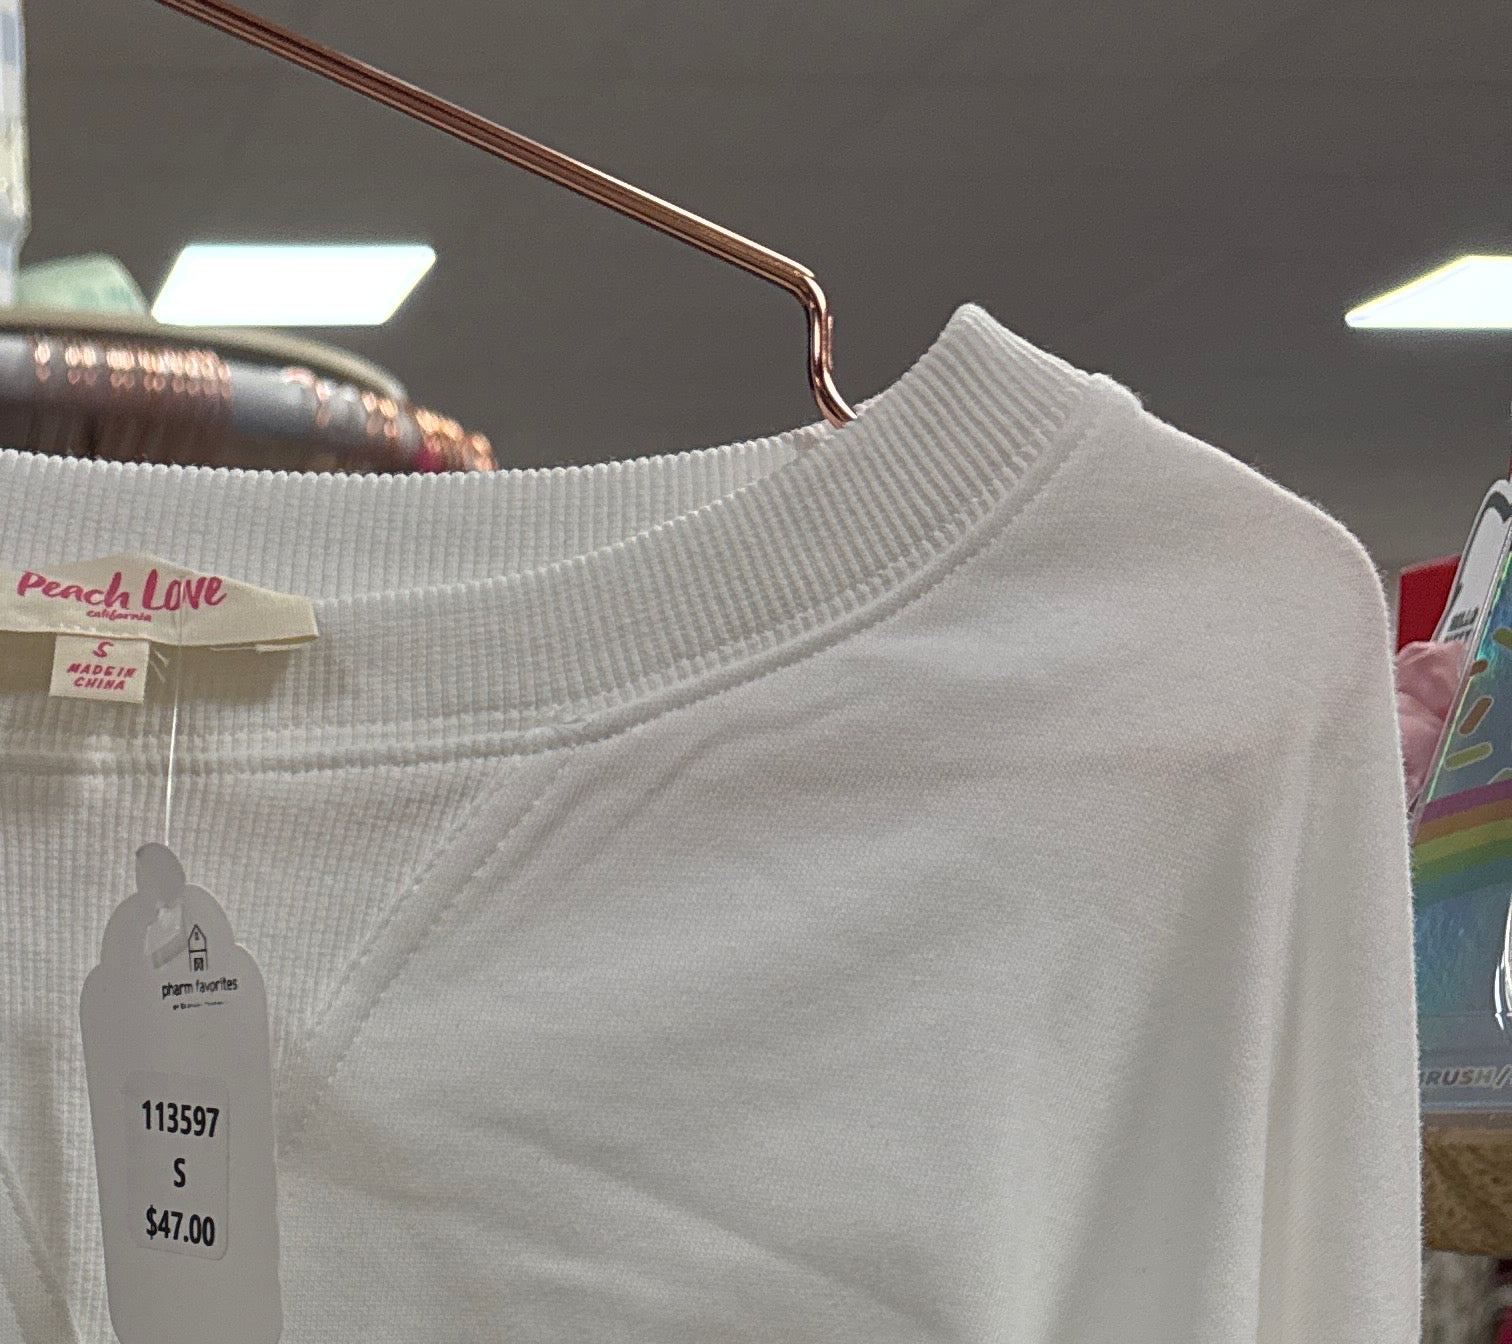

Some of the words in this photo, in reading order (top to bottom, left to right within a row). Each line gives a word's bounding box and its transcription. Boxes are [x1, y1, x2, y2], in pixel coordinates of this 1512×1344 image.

[17, 570, 130, 610] Peach
[87, 609, 152, 622] california
[93, 641, 114, 658] S
[67, 663, 113, 677] MADE
[117, 665, 137, 678] IN
[74, 677, 126, 691] CHINA
[162, 982, 193, 1000] pharm
[196, 977, 238, 994] favorites
[142, 1099, 220, 1138] 113597
[173, 1157, 186, 1188] S
[146, 1204, 215, 1247] $47.00
